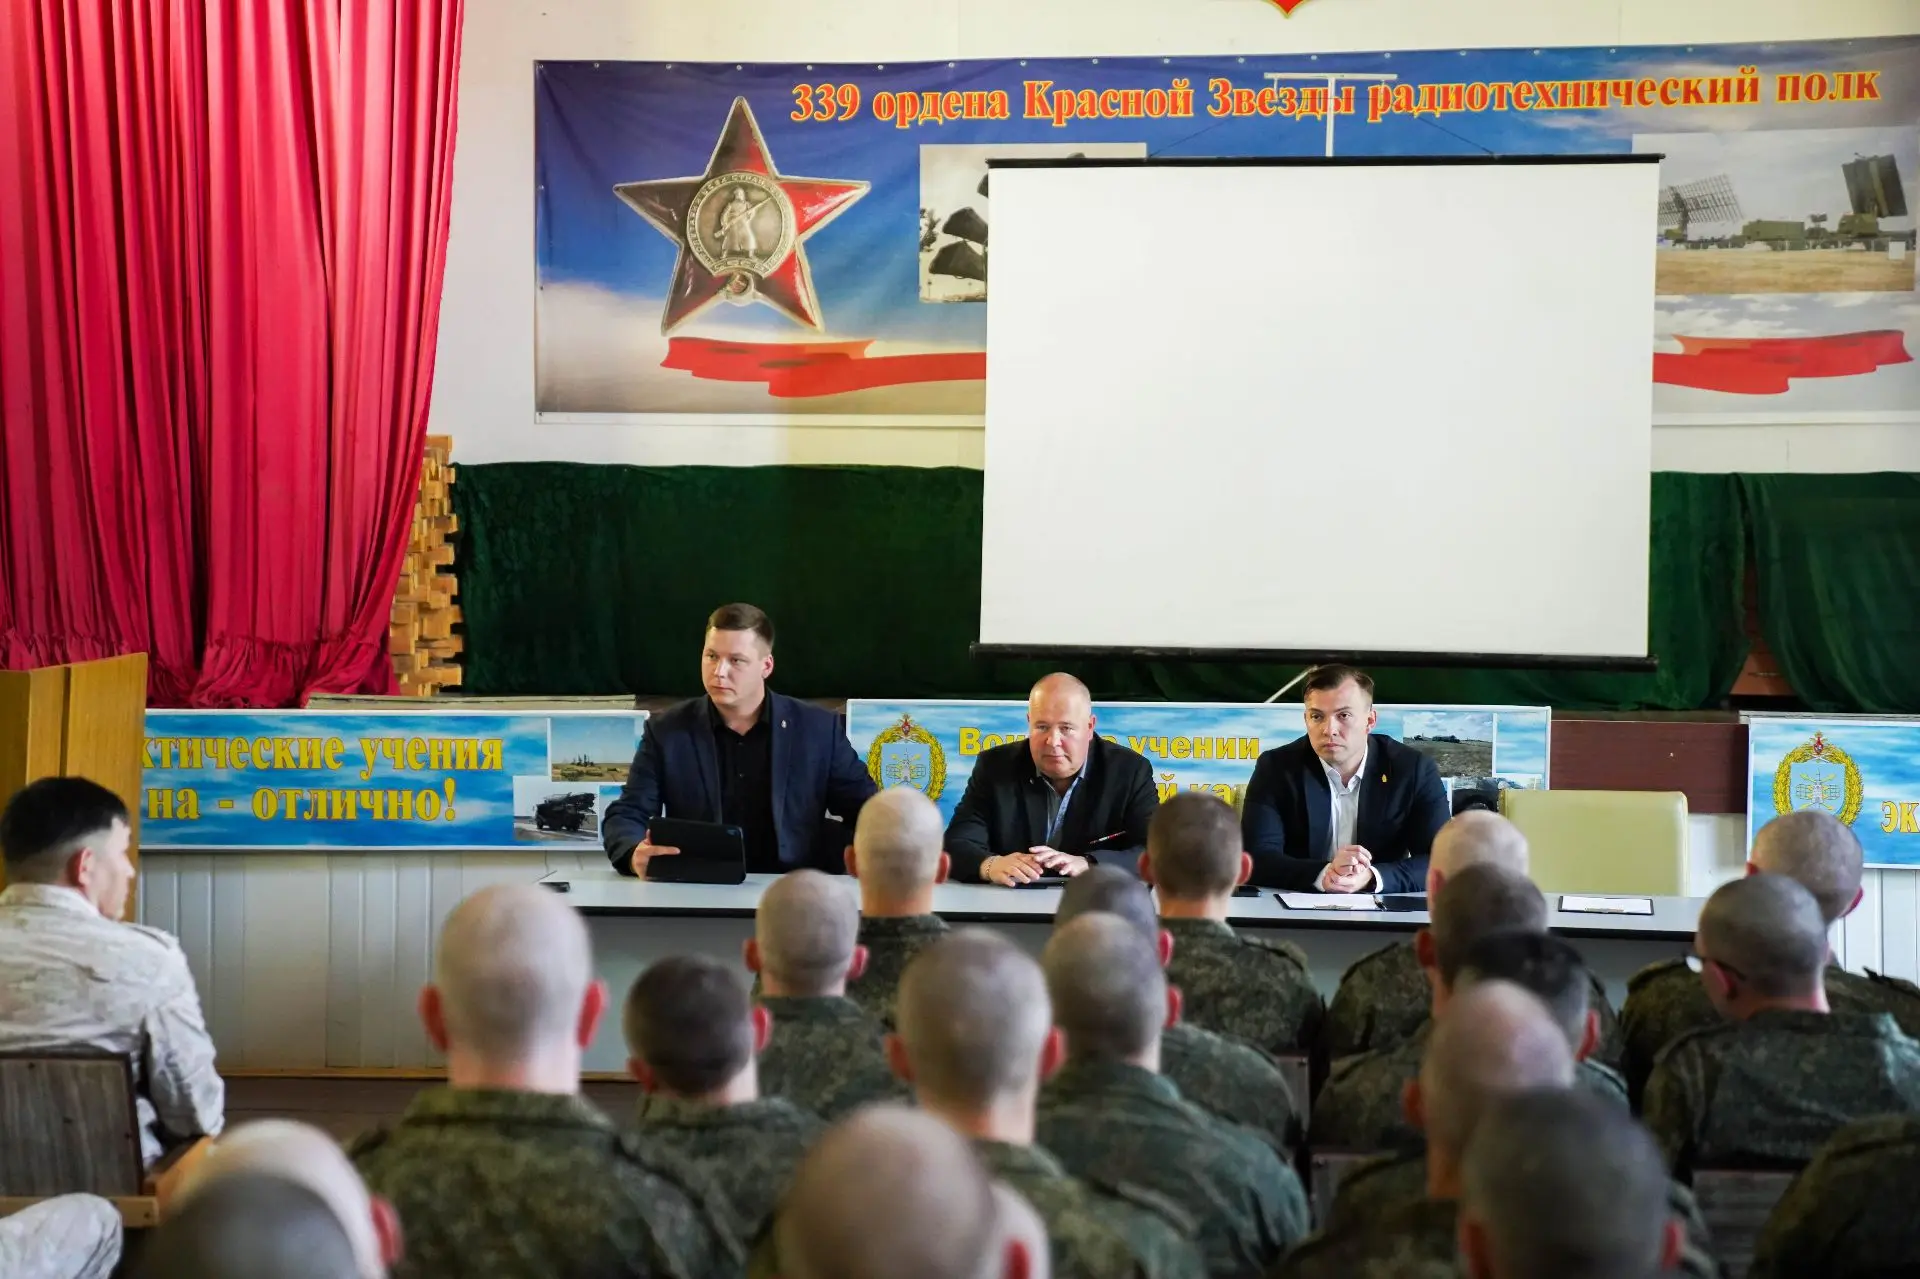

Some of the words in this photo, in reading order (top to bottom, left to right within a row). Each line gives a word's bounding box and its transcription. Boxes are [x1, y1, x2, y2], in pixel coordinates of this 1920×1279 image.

[791, 83, 861, 121] 339
[873, 91, 1009, 128] ордена
[1023, 79, 1193, 126] Красной
[1207, 78, 1355, 121] Звезды
[1367, 65, 1761, 122] радиотехнический
[1775, 70, 1881, 104] полк
[359, 737, 503, 781] учения
[1128, 736, 1259, 760] учении
[146, 787, 201, 820] на
[251, 777, 457, 821] отлично!
